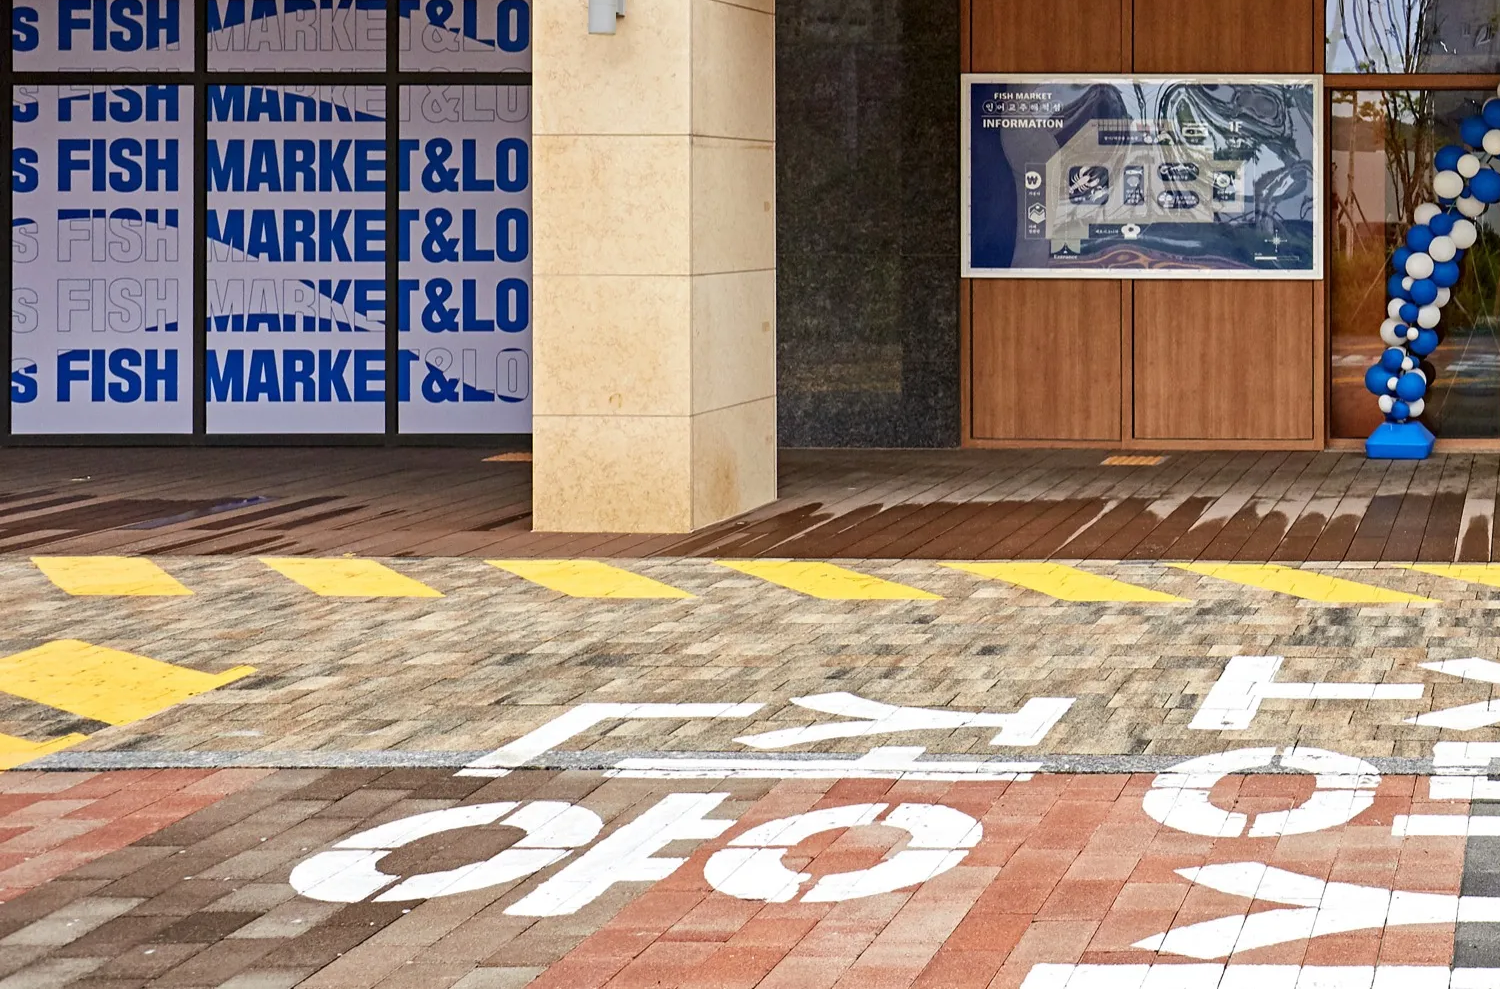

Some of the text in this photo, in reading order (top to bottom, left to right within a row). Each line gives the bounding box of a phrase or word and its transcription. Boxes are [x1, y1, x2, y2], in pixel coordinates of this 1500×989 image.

[57, 68, 180, 122] FISH
[994, 92, 1053, 100] FISH MARKET
[982, 119, 1064, 128] INFORMATION
[57, 138, 180, 193] FISH
[57, 208, 180, 263] FISH
[57, 278, 180, 333] FISH
[57, 348, 180, 403] FISH
